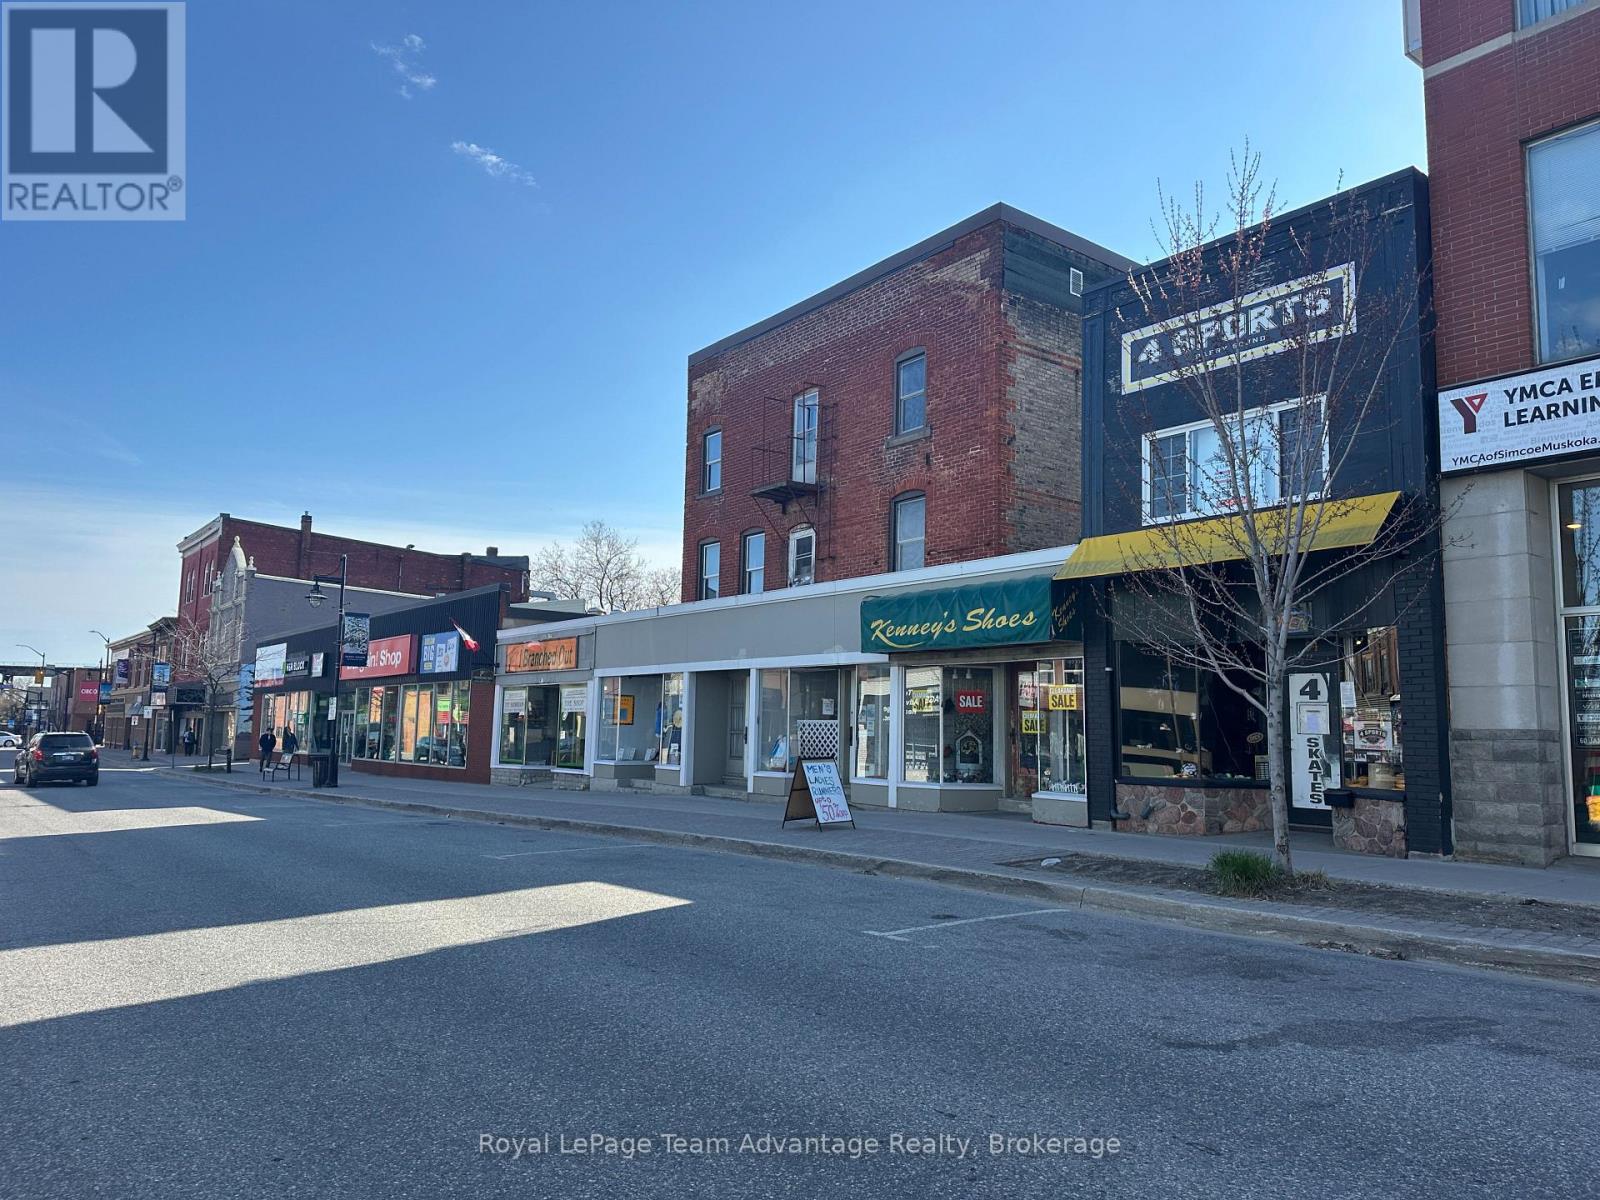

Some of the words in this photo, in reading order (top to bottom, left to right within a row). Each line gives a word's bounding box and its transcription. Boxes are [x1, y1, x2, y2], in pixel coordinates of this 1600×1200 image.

[1172, 287, 1331, 356] SPORTS
[1504, 377, 1573, 404] YMCA
[871, 611, 957, 648] Kenney's
[963, 607, 1037, 632] Shoes
[380, 649, 402, 668] Shop
[558, 644, 573, 665] Out
[1300, 679, 1321, 700] 4
[960, 696, 983, 708] SALE
[1052, 695, 1075, 708] SALE
[1025, 719, 1045, 731] SALE
[807, 764, 831, 774] MEN'S
[1306, 737, 1323, 804] SKATES
[808, 776, 835, 786] LADIES
